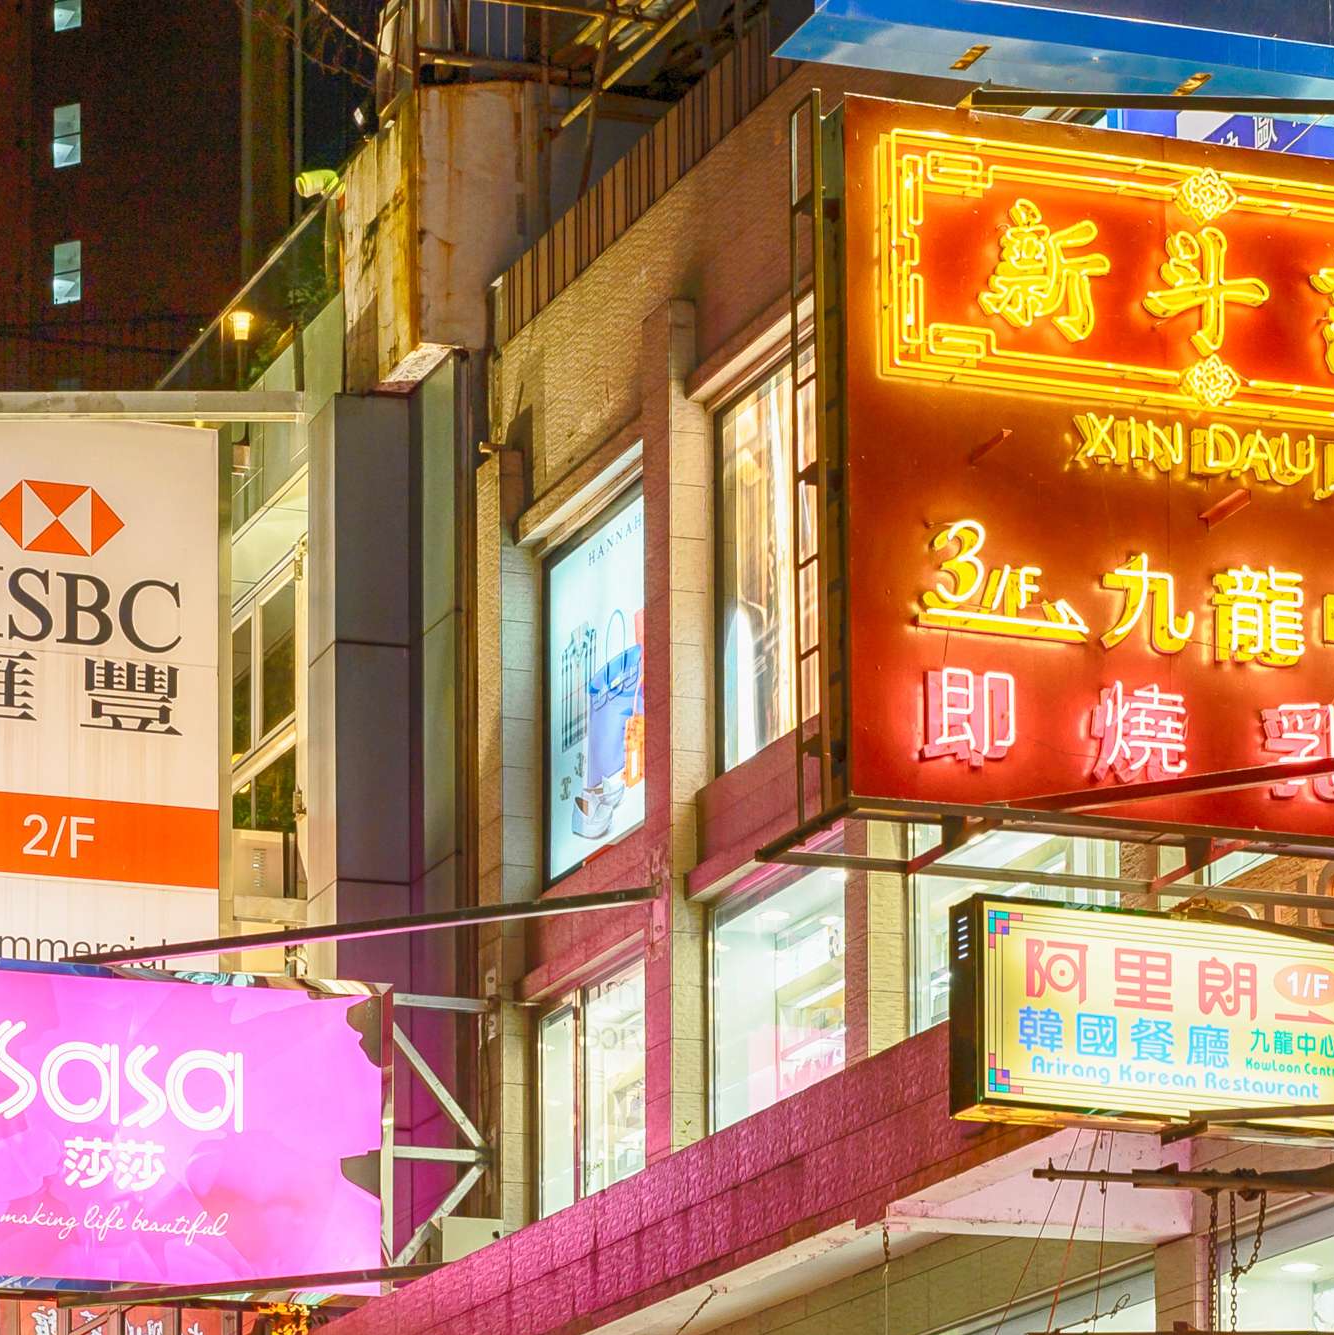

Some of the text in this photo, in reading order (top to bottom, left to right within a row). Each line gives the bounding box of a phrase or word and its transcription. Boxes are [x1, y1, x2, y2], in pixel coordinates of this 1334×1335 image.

[1070, 412, 1183, 472] XIN
[1190, 423, 1316, 487] DAU
[22, 813, 95, 861] 2/F
[1024, 937, 1330, 1022] 阿里朗 1/F
[1017, 1005, 1230, 1070] 韓國餐廳
[1031, 1055, 1320, 1099] Arirang Korean Restaurant
[63, 1134, 166, 1193] 莎莎
[0, 1203, 230, 1248] making life beautiful
